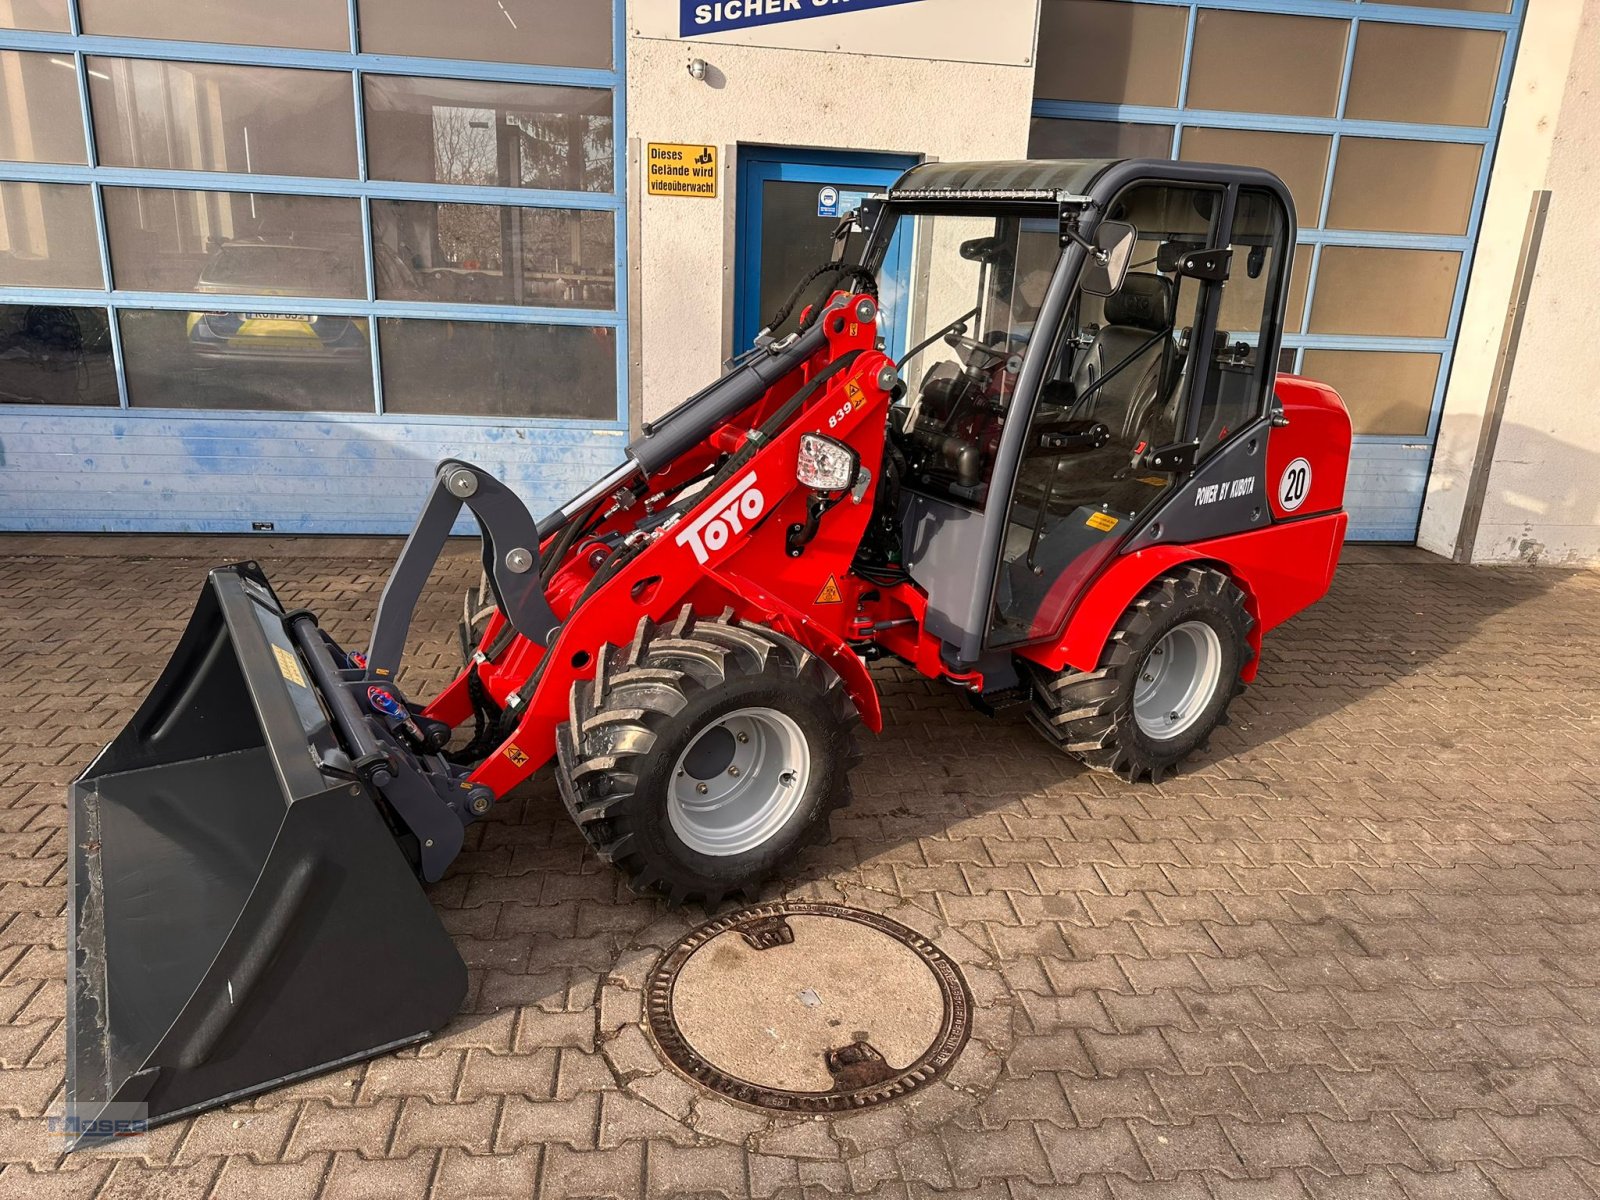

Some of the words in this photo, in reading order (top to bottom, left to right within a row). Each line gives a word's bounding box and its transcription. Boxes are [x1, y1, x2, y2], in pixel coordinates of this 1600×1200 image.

[694, 0, 801, 24] SICHER
[651, 147, 683, 160] Dieses
[651, 163, 690, 176] Gelände
[692, 166, 713, 177] wird
[651, 179, 714, 193] videoüberwacht
[828, 401, 852, 428] 839
[1194, 484, 1219, 507] POWER
[1219, 481, 1231, 501] BY
[1229, 476, 1255, 498] KUBOTA
[1284, 467, 1306, 502] 20
[675, 470, 764, 565] TOYO
